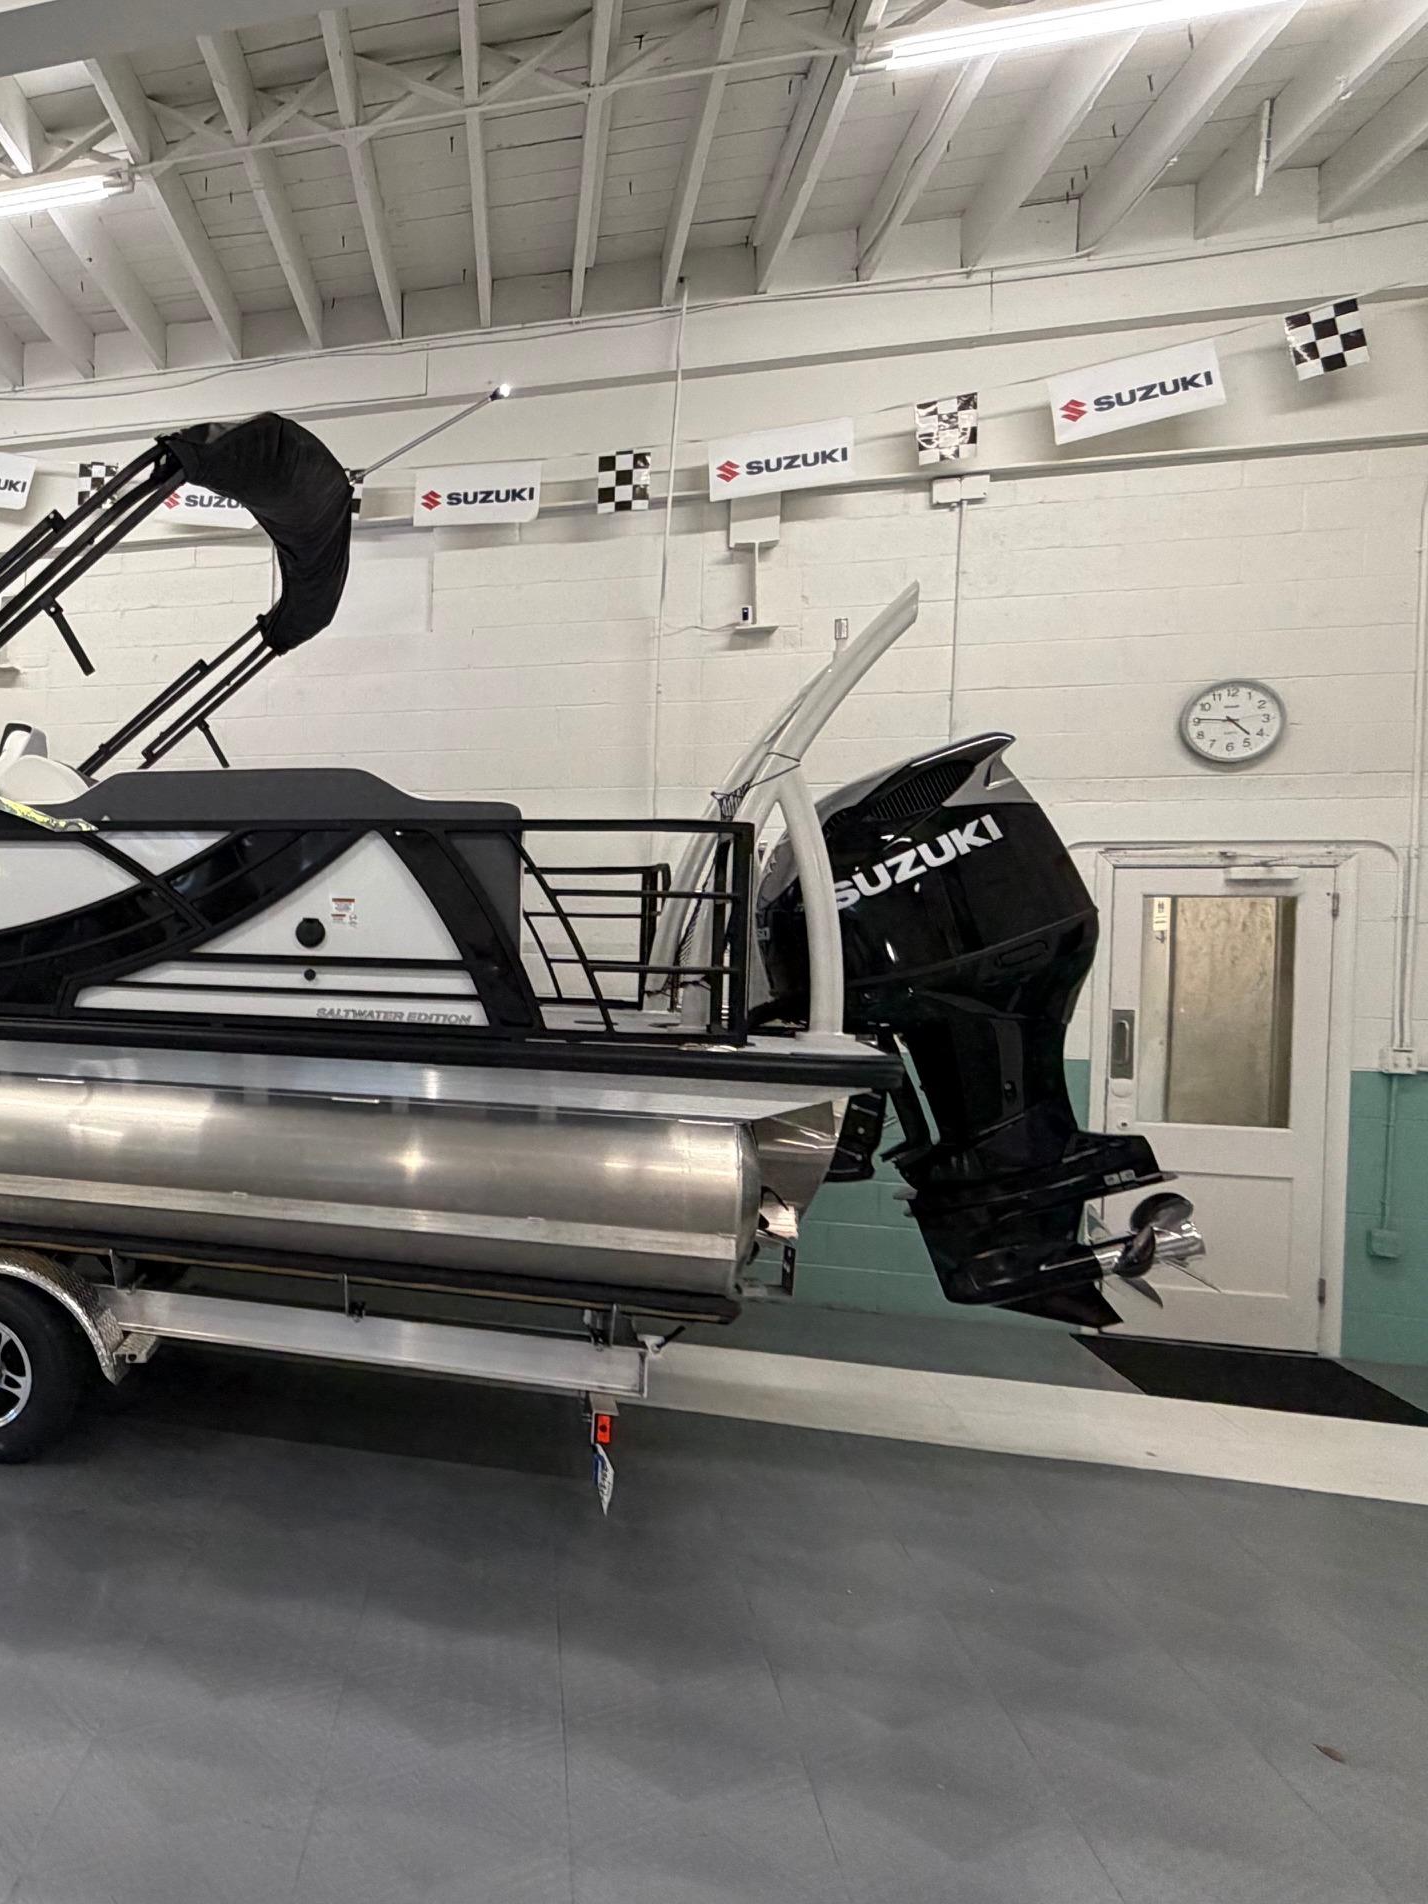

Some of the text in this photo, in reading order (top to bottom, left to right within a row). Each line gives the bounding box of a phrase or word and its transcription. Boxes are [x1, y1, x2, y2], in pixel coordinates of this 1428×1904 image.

[1094, 371, 1214, 412] SUZUKI
[745, 446, 848, 475] SUZUKI
[184, 494, 246, 509] SUZU
[446, 487, 535, 506] SUZUKI
[1227, 687, 1239, 697] 12
[1247, 692, 1252, 700] 1
[1212, 693, 1222, 702] 11
[1199, 702, 1211, 712] 10
[1257, 700, 1266, 709] 2
[1193, 717, 1201, 726] 9
[1262, 714, 1270, 723] 3
[1196, 731, 1205, 740] 8
[1256, 728, 1264, 737] 4
[1209, 739, 1216, 748] 7
[1225, 742, 1234, 752] 6
[1243, 738, 1251, 748] 5
[834, 814, 1004, 911] SUZUKI
[316, 1007, 472, 1025] SALTWATER EDITION
